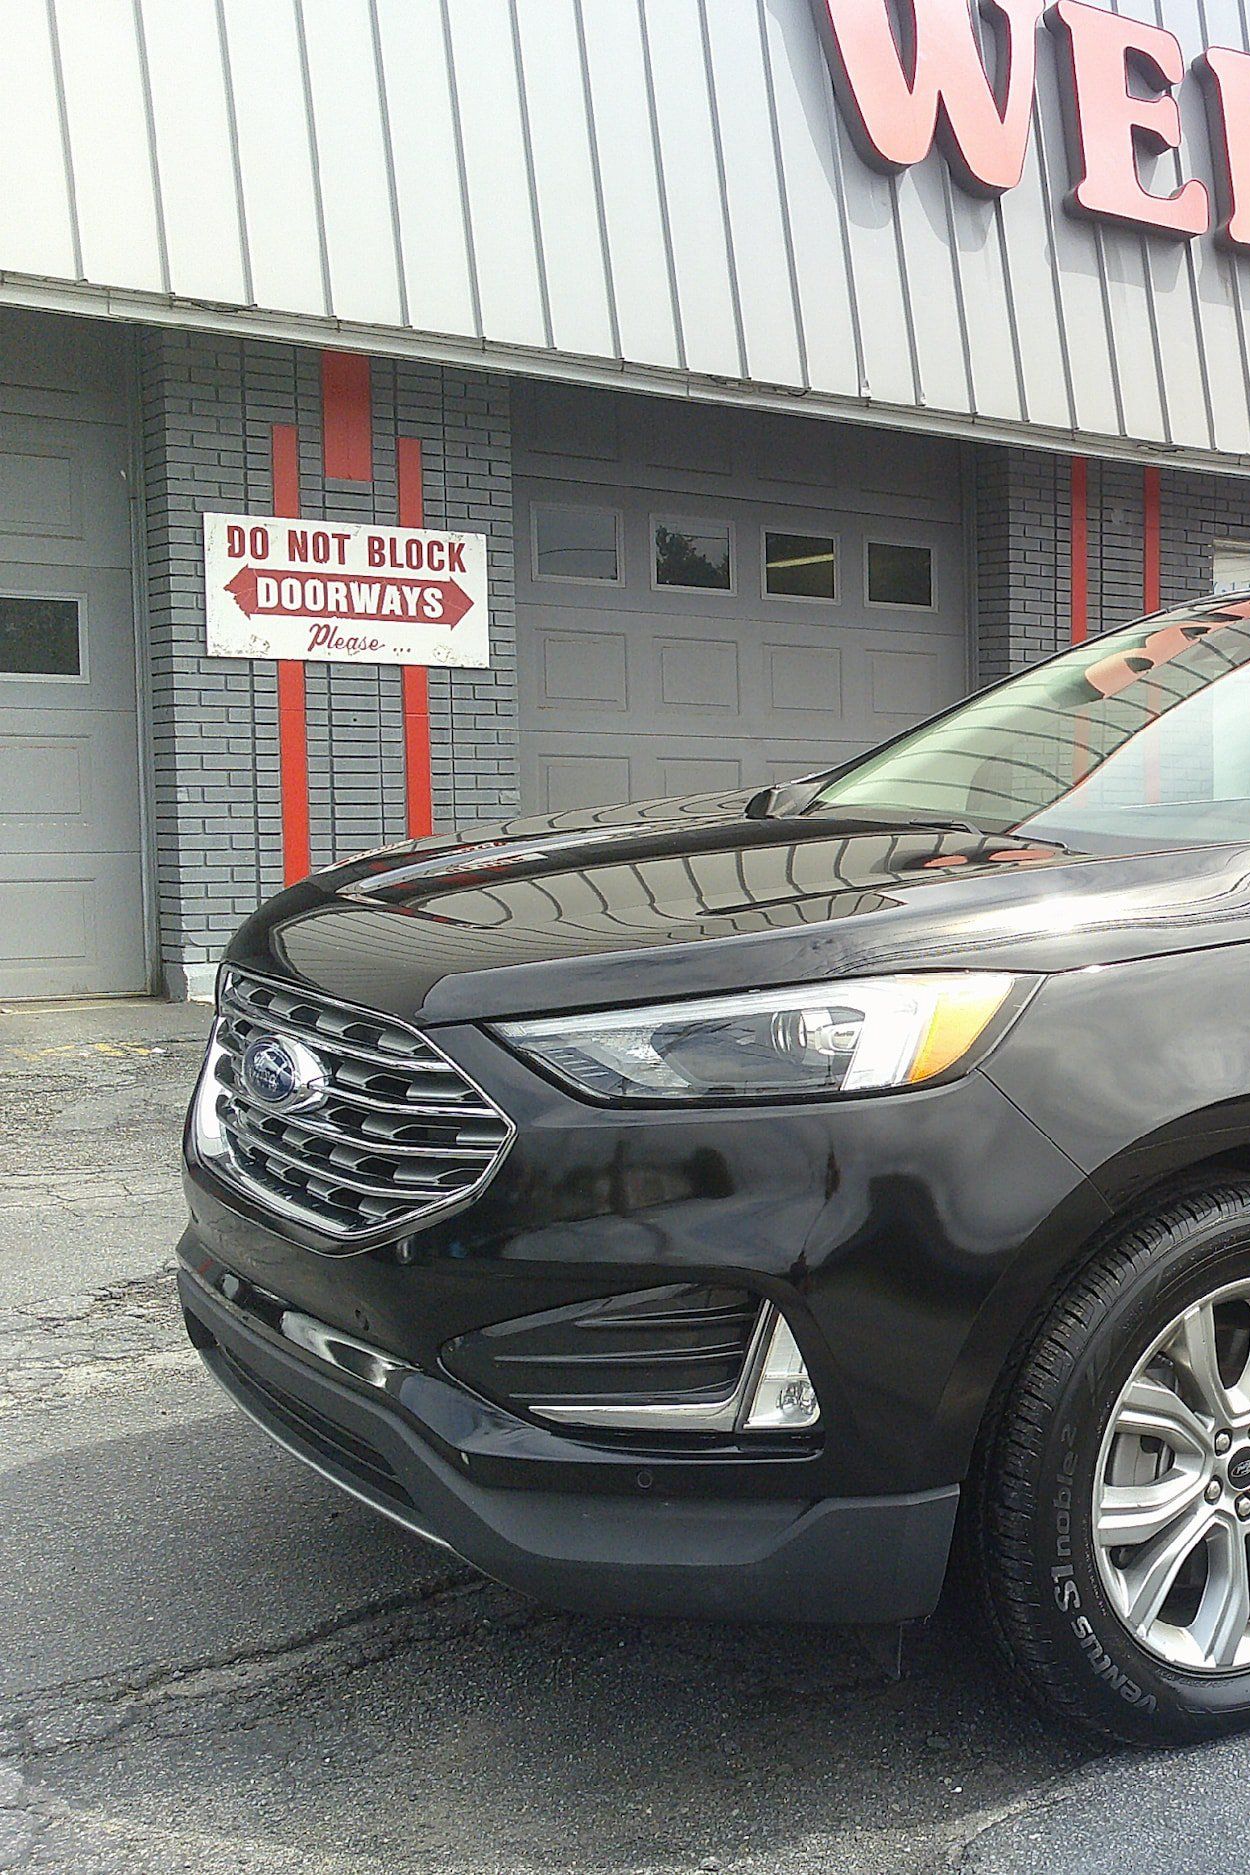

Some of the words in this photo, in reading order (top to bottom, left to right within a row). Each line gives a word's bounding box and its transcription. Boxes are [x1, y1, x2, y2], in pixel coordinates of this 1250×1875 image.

[226, 525, 270, 560] DO
[287, 529, 351, 565] NOT
[367, 535, 467, 573] BLOCK
[256, 575, 444, 618] DOORWAYS
[307, 623, 385, 652] Please
